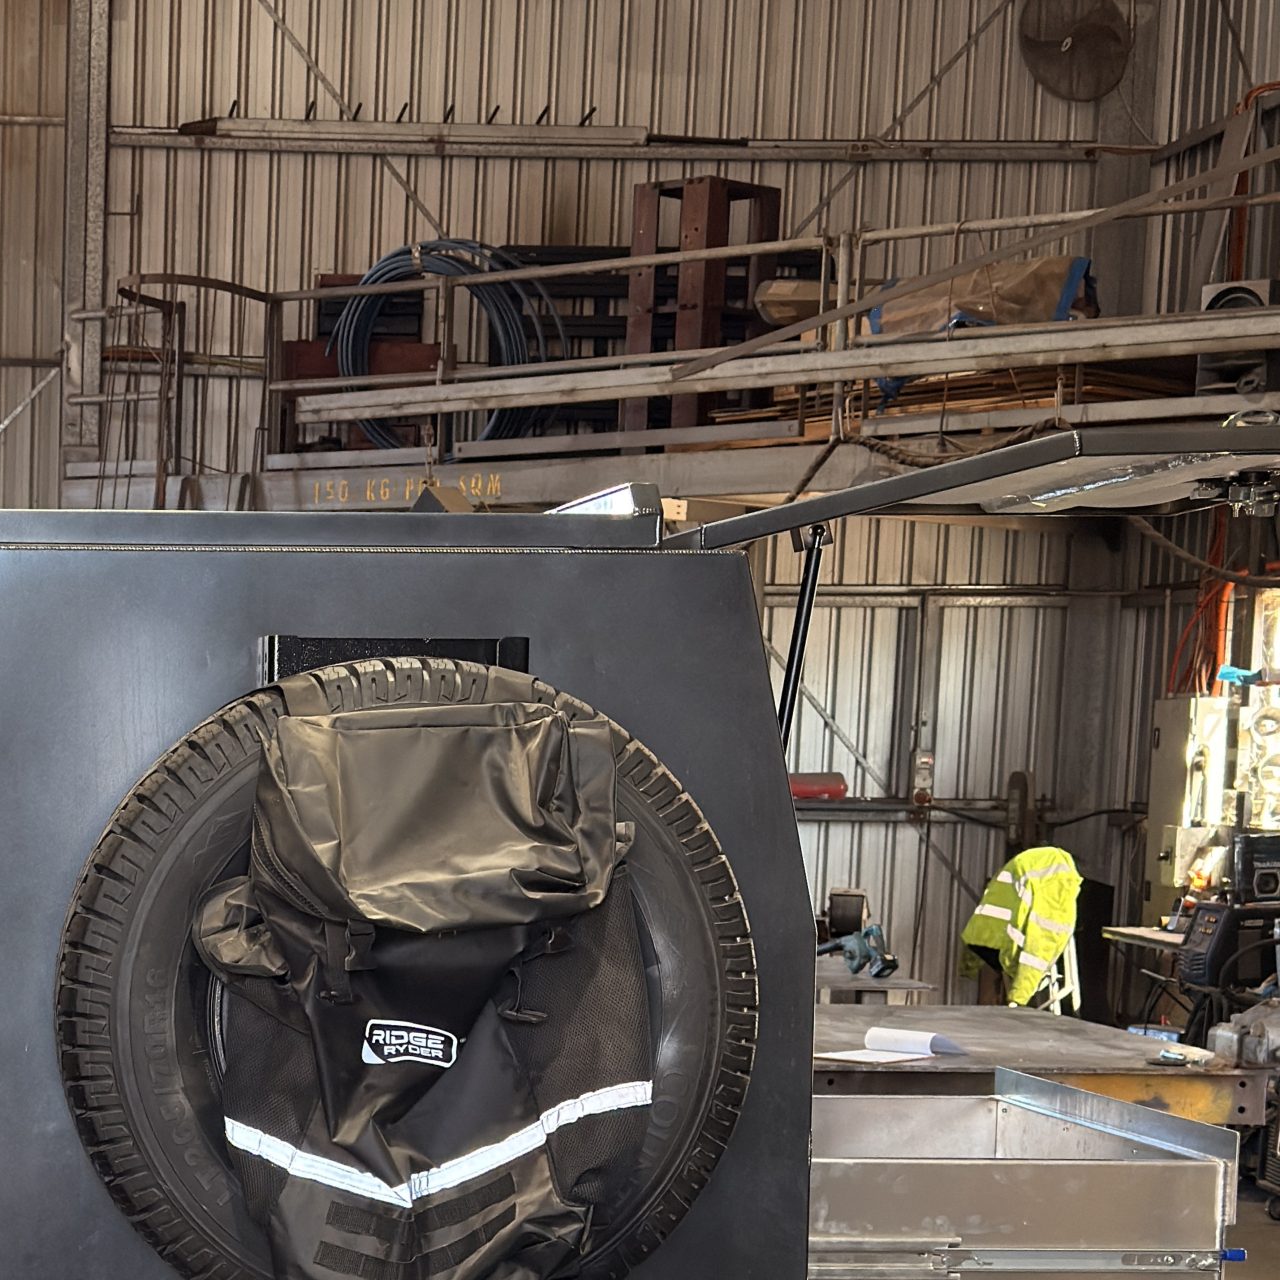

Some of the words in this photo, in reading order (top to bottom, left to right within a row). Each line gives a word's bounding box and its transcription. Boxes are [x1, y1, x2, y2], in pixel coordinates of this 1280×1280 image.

[313, 480, 349, 504] 150
[366, 478, 390, 501] KG
[372, 1029, 445, 1049] RIDGE
[383, 1044, 443, 1058] RYDER
